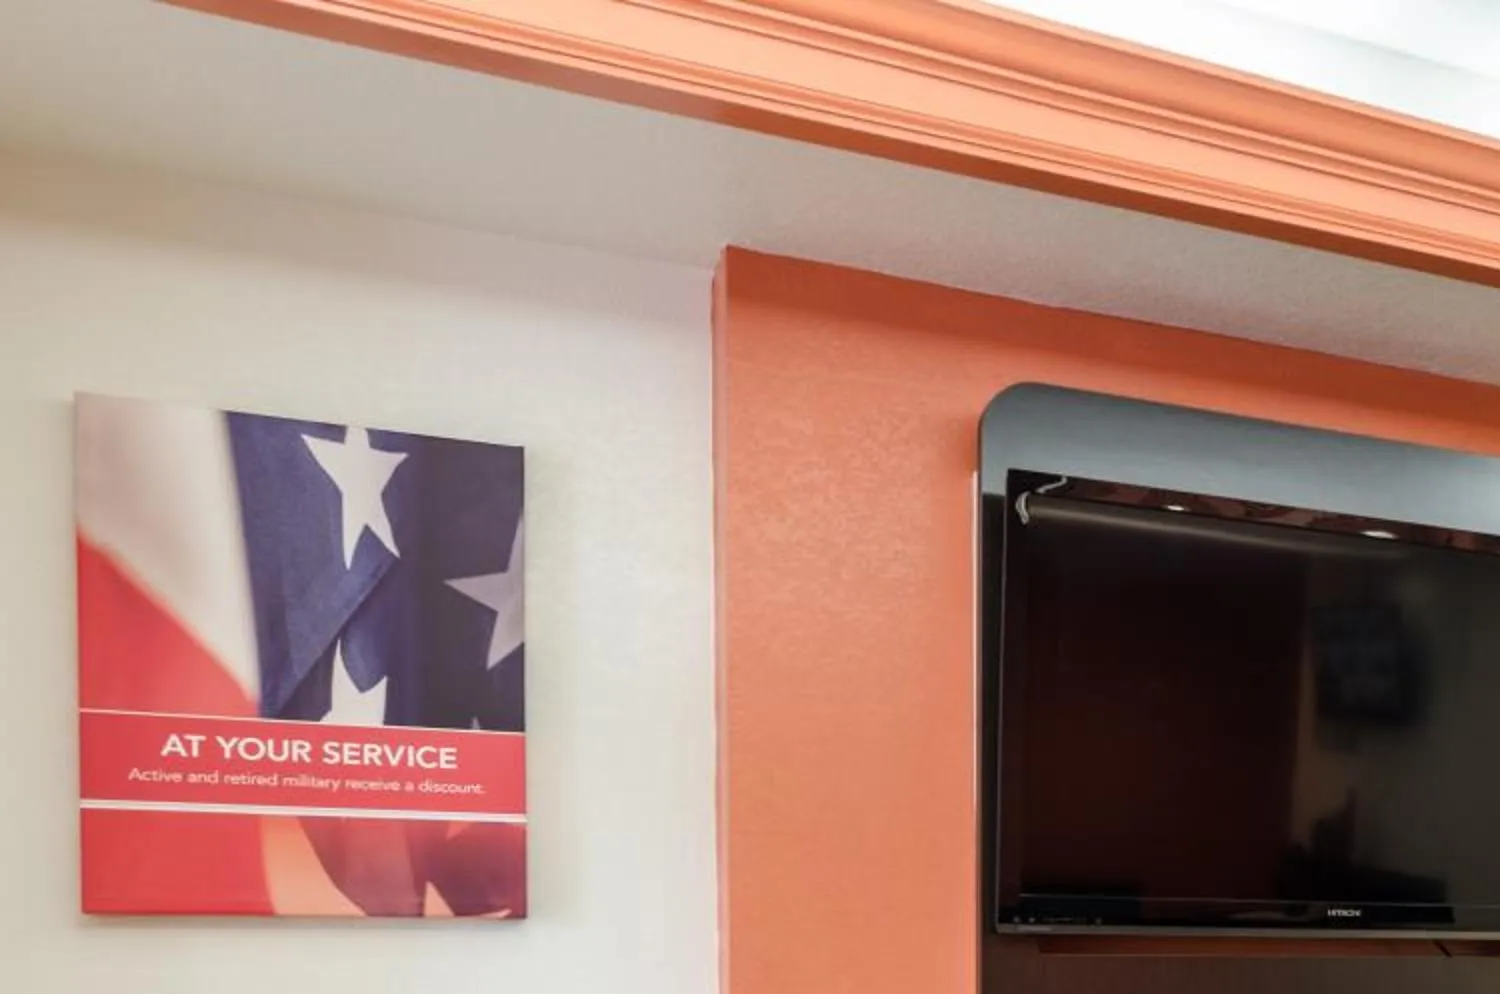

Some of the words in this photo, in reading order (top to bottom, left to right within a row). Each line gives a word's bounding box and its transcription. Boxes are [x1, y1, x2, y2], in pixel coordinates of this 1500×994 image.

[160, 732, 207, 758] AT
[215, 735, 312, 763] YOUR
[322, 739, 458, 769] SERVICE
[128, 767, 183, 783] Active
[187, 770, 219, 785] and
[223, 772, 278, 787] retired
[282, 774, 341, 792] military
[345, 777, 401, 791] receive
[404, 781, 415, 792] a
[419, 777, 486, 795] discount.
